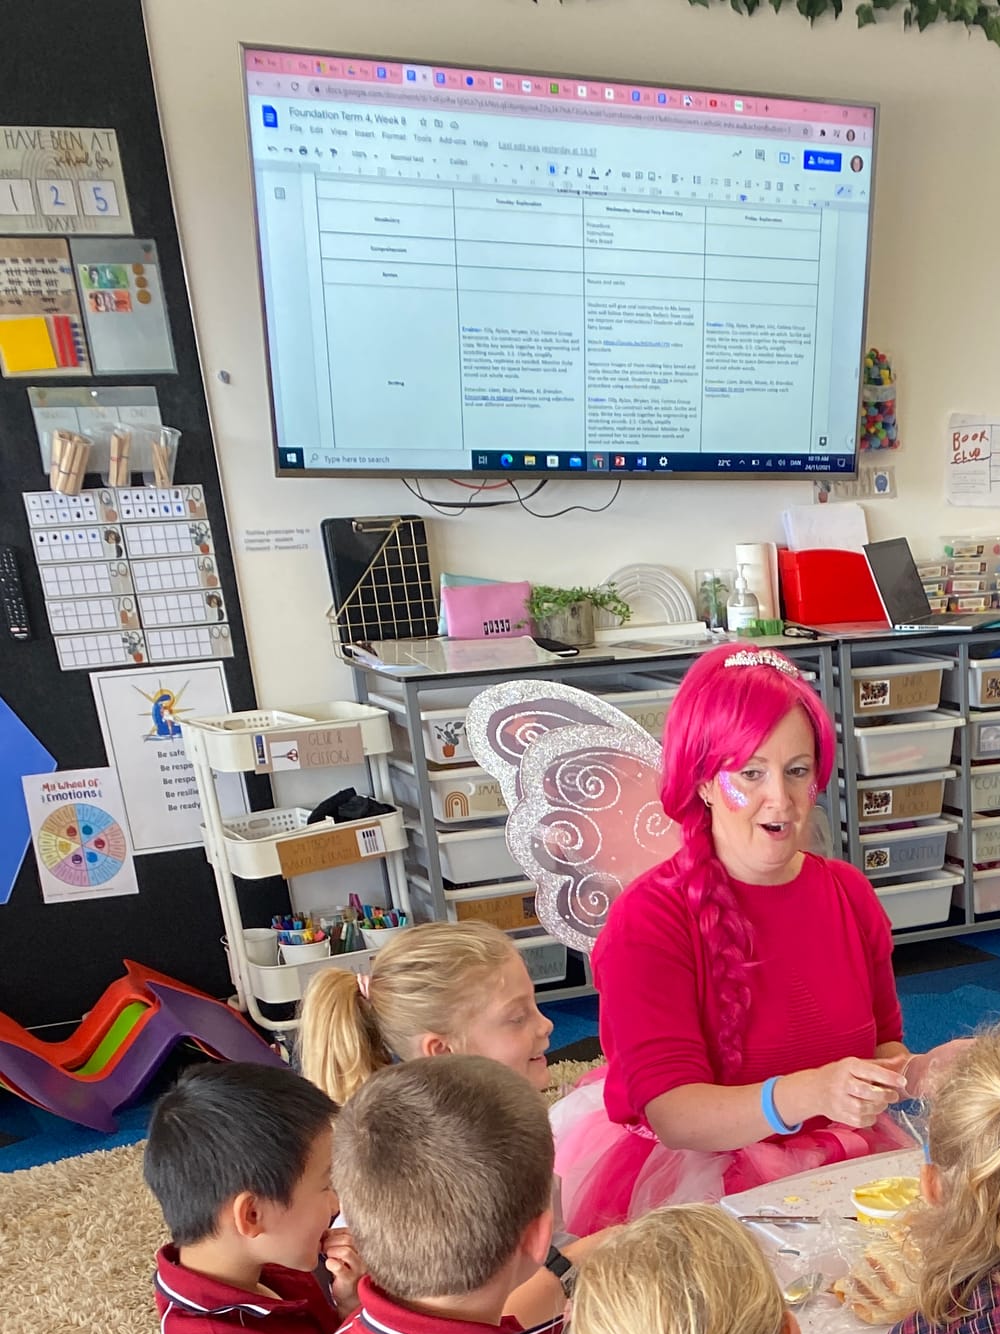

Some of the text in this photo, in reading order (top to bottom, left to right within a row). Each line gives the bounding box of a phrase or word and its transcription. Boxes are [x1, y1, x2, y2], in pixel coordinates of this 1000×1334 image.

[289, 107, 339, 121] Foundation
[341, 111, 363, 122] Term
[374, 114, 398, 125] Week
[4, 130, 45, 150] HAVE
[91, 131, 114, 152] AT
[50, 185, 66, 206] 2
[92, 186, 109, 212] 5
[324, 456, 340, 464] Type
[342, 456, 357, 464] here
[367, 456, 390, 464] search
